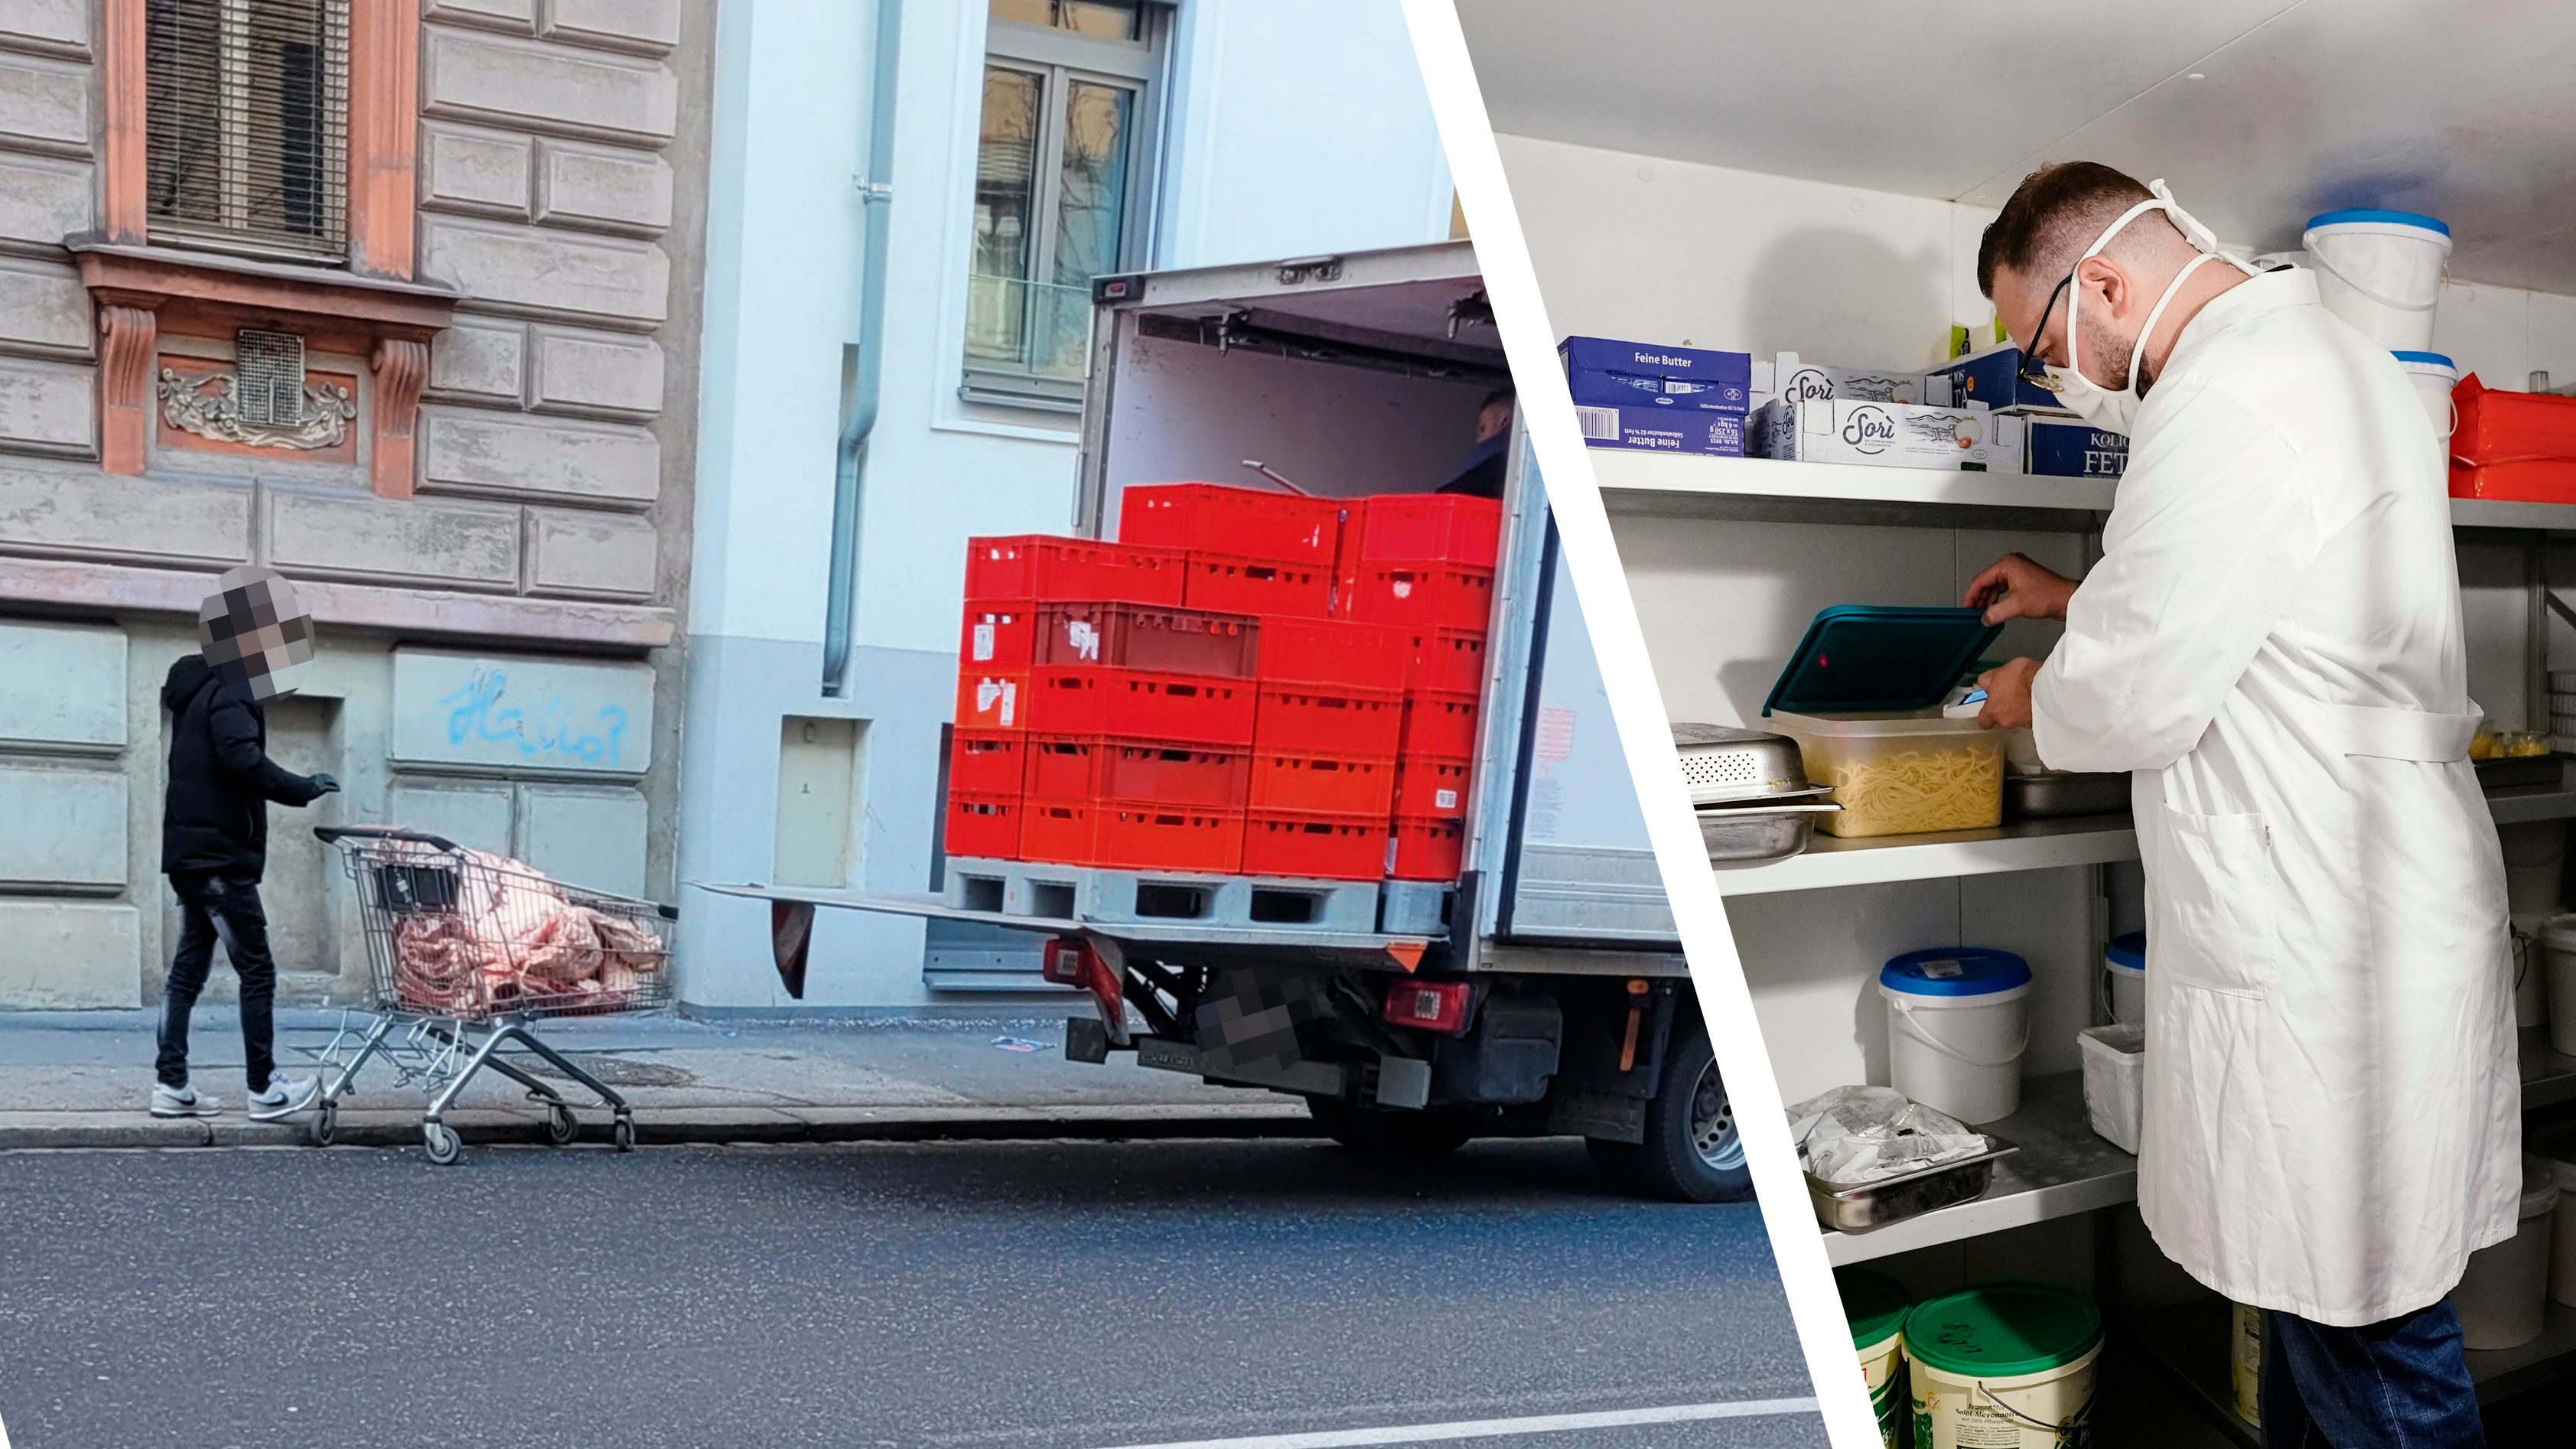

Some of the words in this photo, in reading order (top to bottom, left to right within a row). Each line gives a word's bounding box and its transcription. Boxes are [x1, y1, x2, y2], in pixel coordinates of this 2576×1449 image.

[1635, 352, 1659, 364] Feine
[1662, 355, 1692, 367] Butter
[1647, 430, 1684, 438] Süßrahmbutter
[1628, 436, 1655, 448] Butter
[1657, 438, 1680, 448] Feine
